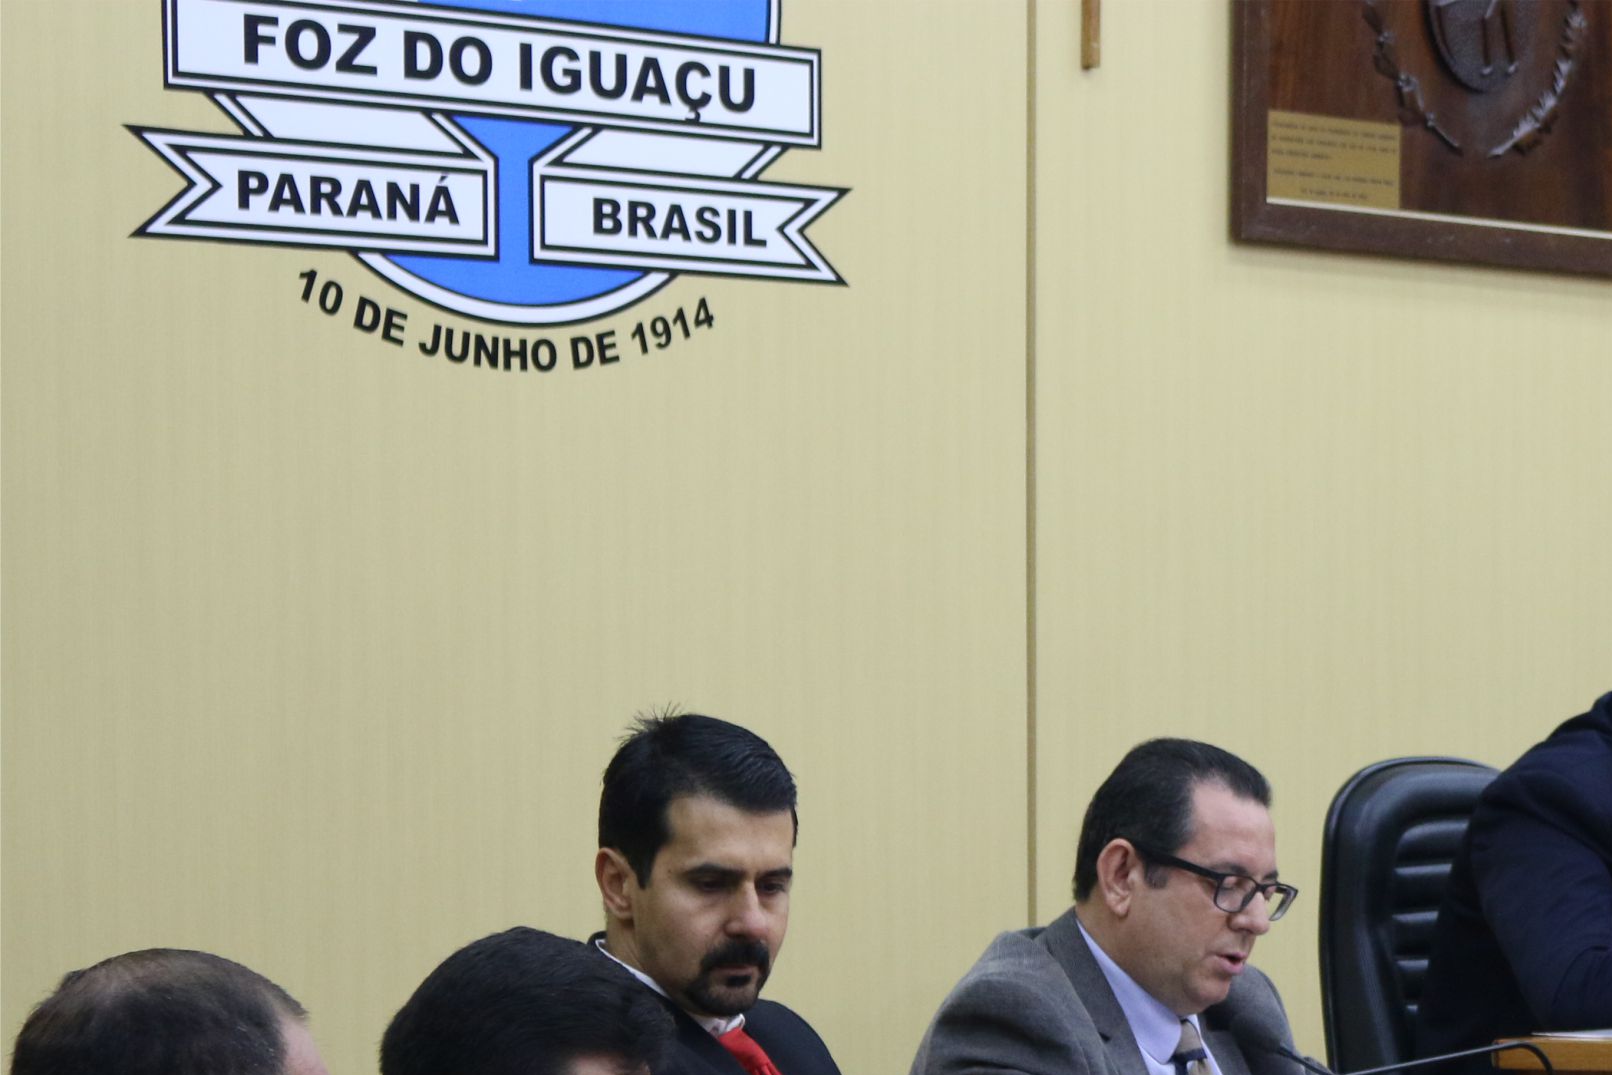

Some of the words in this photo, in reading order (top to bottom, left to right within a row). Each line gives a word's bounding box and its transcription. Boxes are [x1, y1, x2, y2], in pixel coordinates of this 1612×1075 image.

[243, 14, 378, 77] FOZ
[403, 31, 494, 86] DO
[519, 43, 756, 123] IGUAÇU
[236, 169, 460, 224] PARANÁ
[593, 198, 767, 248] BRASIL
[298, 268, 343, 316] 10
[353, 300, 405, 348] DE
[418, 326, 558, 373] JUNHO
[570, 331, 620, 370] DE
[629, 297, 717, 358] 1914
